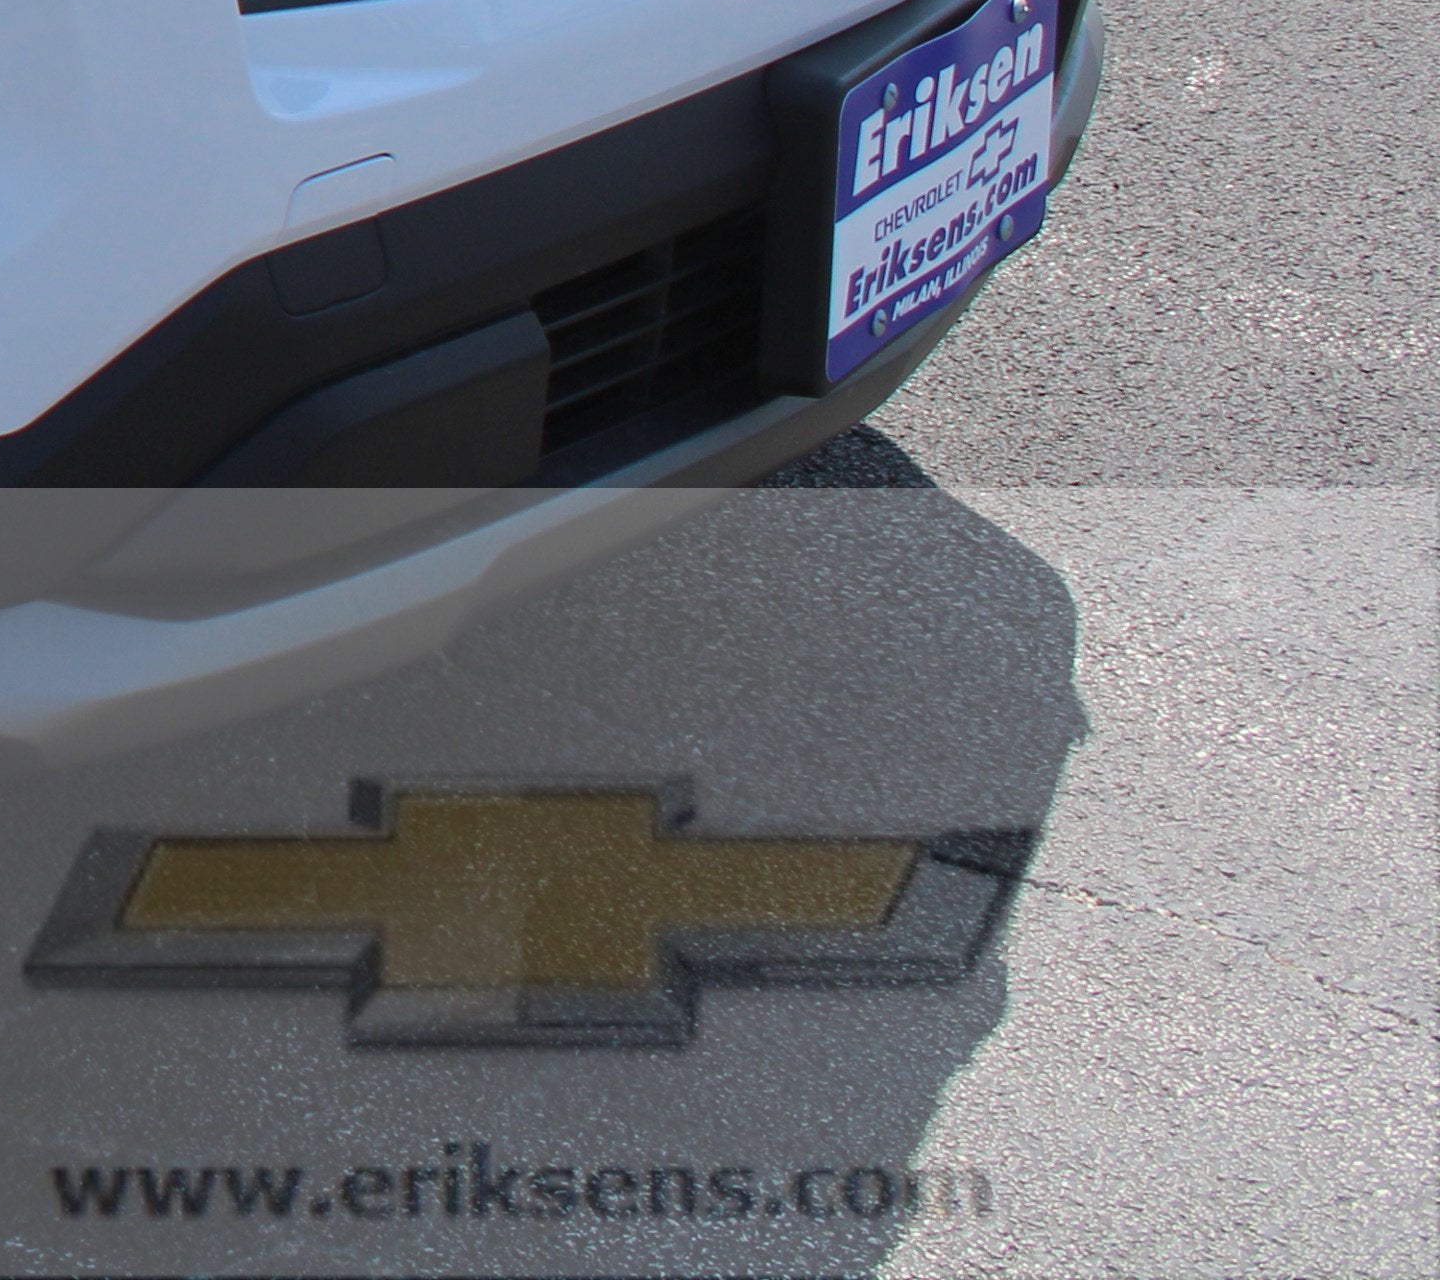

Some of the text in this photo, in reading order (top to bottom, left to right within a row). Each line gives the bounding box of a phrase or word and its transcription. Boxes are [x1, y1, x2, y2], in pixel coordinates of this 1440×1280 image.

[852, 22, 1044, 197] Eriksen
[844, 152, 1038, 319] Eriksens.com
[874, 169, 964, 243] CHEVROLET
[891, 275, 943, 322] MILAN,
